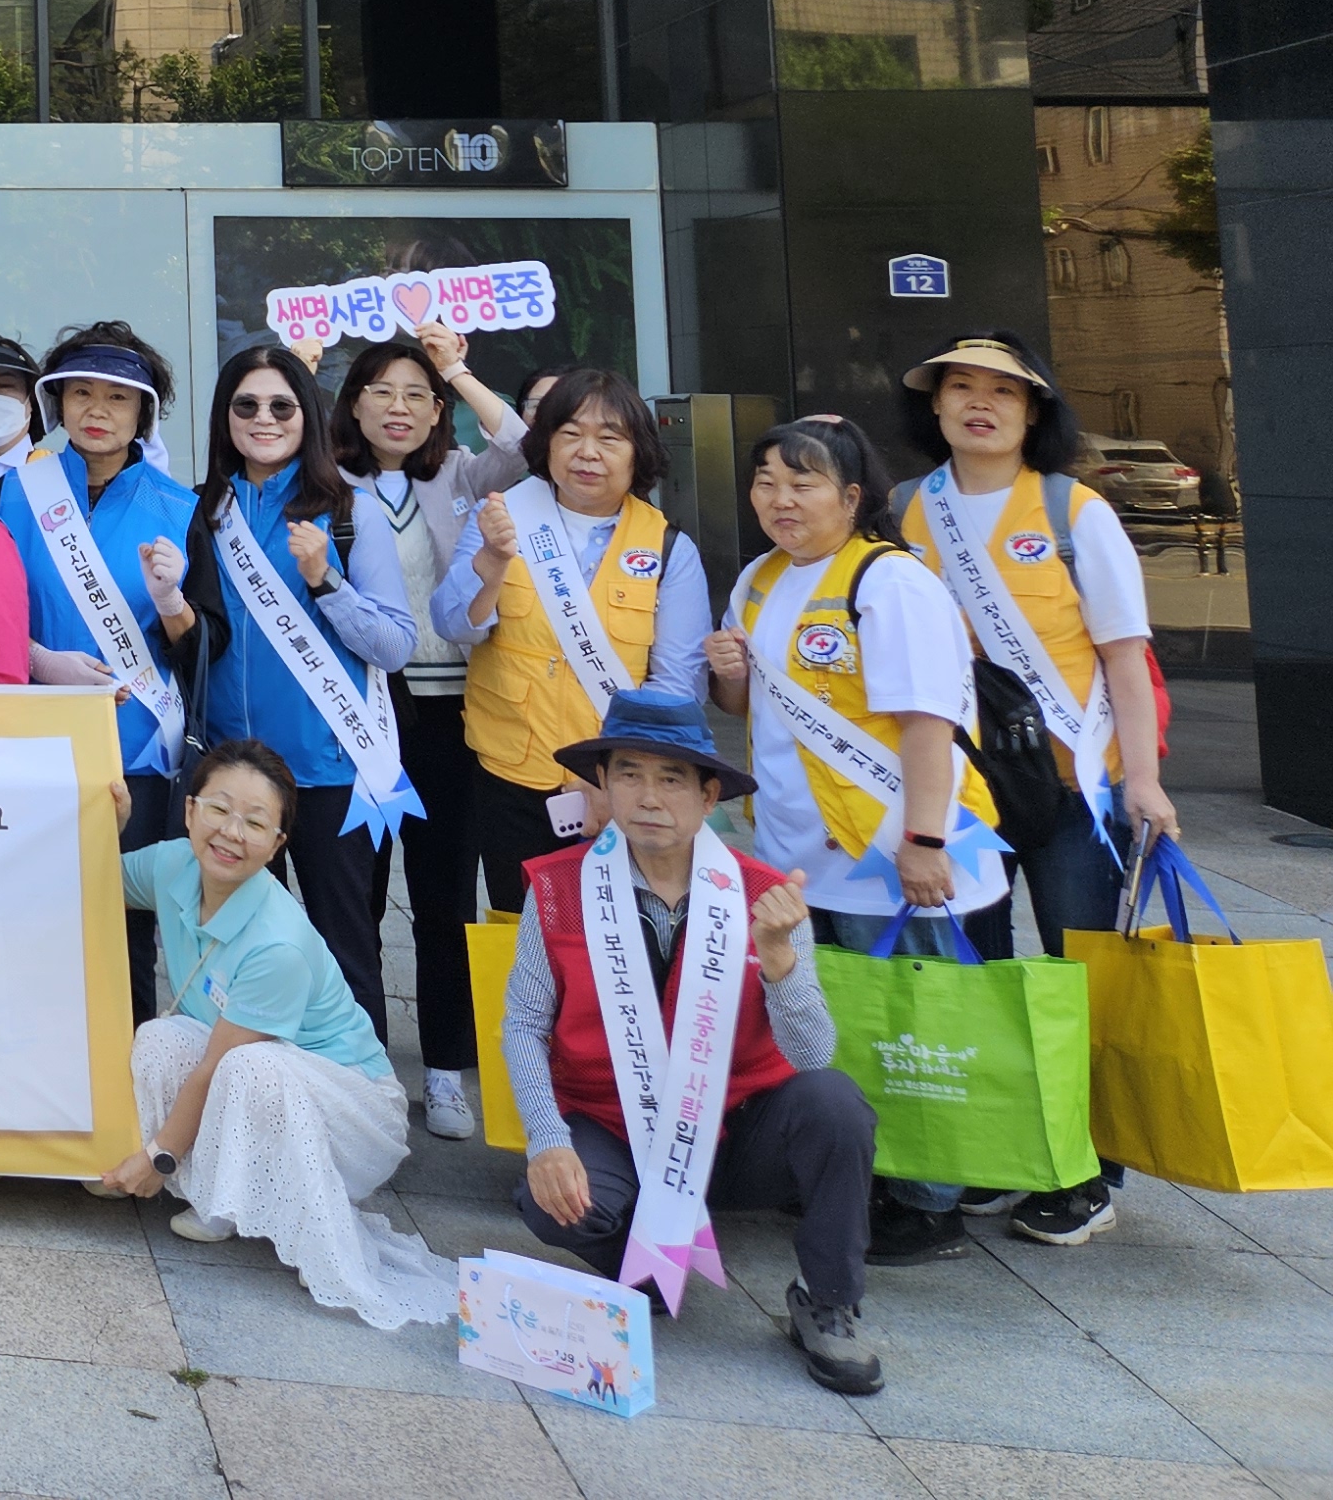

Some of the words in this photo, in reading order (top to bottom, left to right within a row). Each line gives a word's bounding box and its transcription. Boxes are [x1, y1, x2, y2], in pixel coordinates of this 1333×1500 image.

[277, 286, 386, 340] 생명사랑
[438, 270, 544, 323] 생명존중
[906, 275, 934, 291] 12
[60, 532, 111, 610] 당신곁엔
[102, 613, 139, 670] 언제나
[548, 566, 577, 618] 중독은
[570, 621, 606, 673] 치료가
[935, 497, 964, 544] 거제시
[957, 549, 990, 600] 보건소
[982, 601, 1082, 735] 정신건강복지센터
[229, 536, 280, 609] 토닥토닥
[277, 614, 324, 673] 오늘도
[322, 676, 375, 749] 수고했어
[595, 864, 618, 925] 거제시
[604, 933, 634, 995] 보건소
[701, 904, 731, 982] 당신은
[690, 990, 718, 1065] 소중한
[664, 1074, 709, 1197] 사람입니다.
